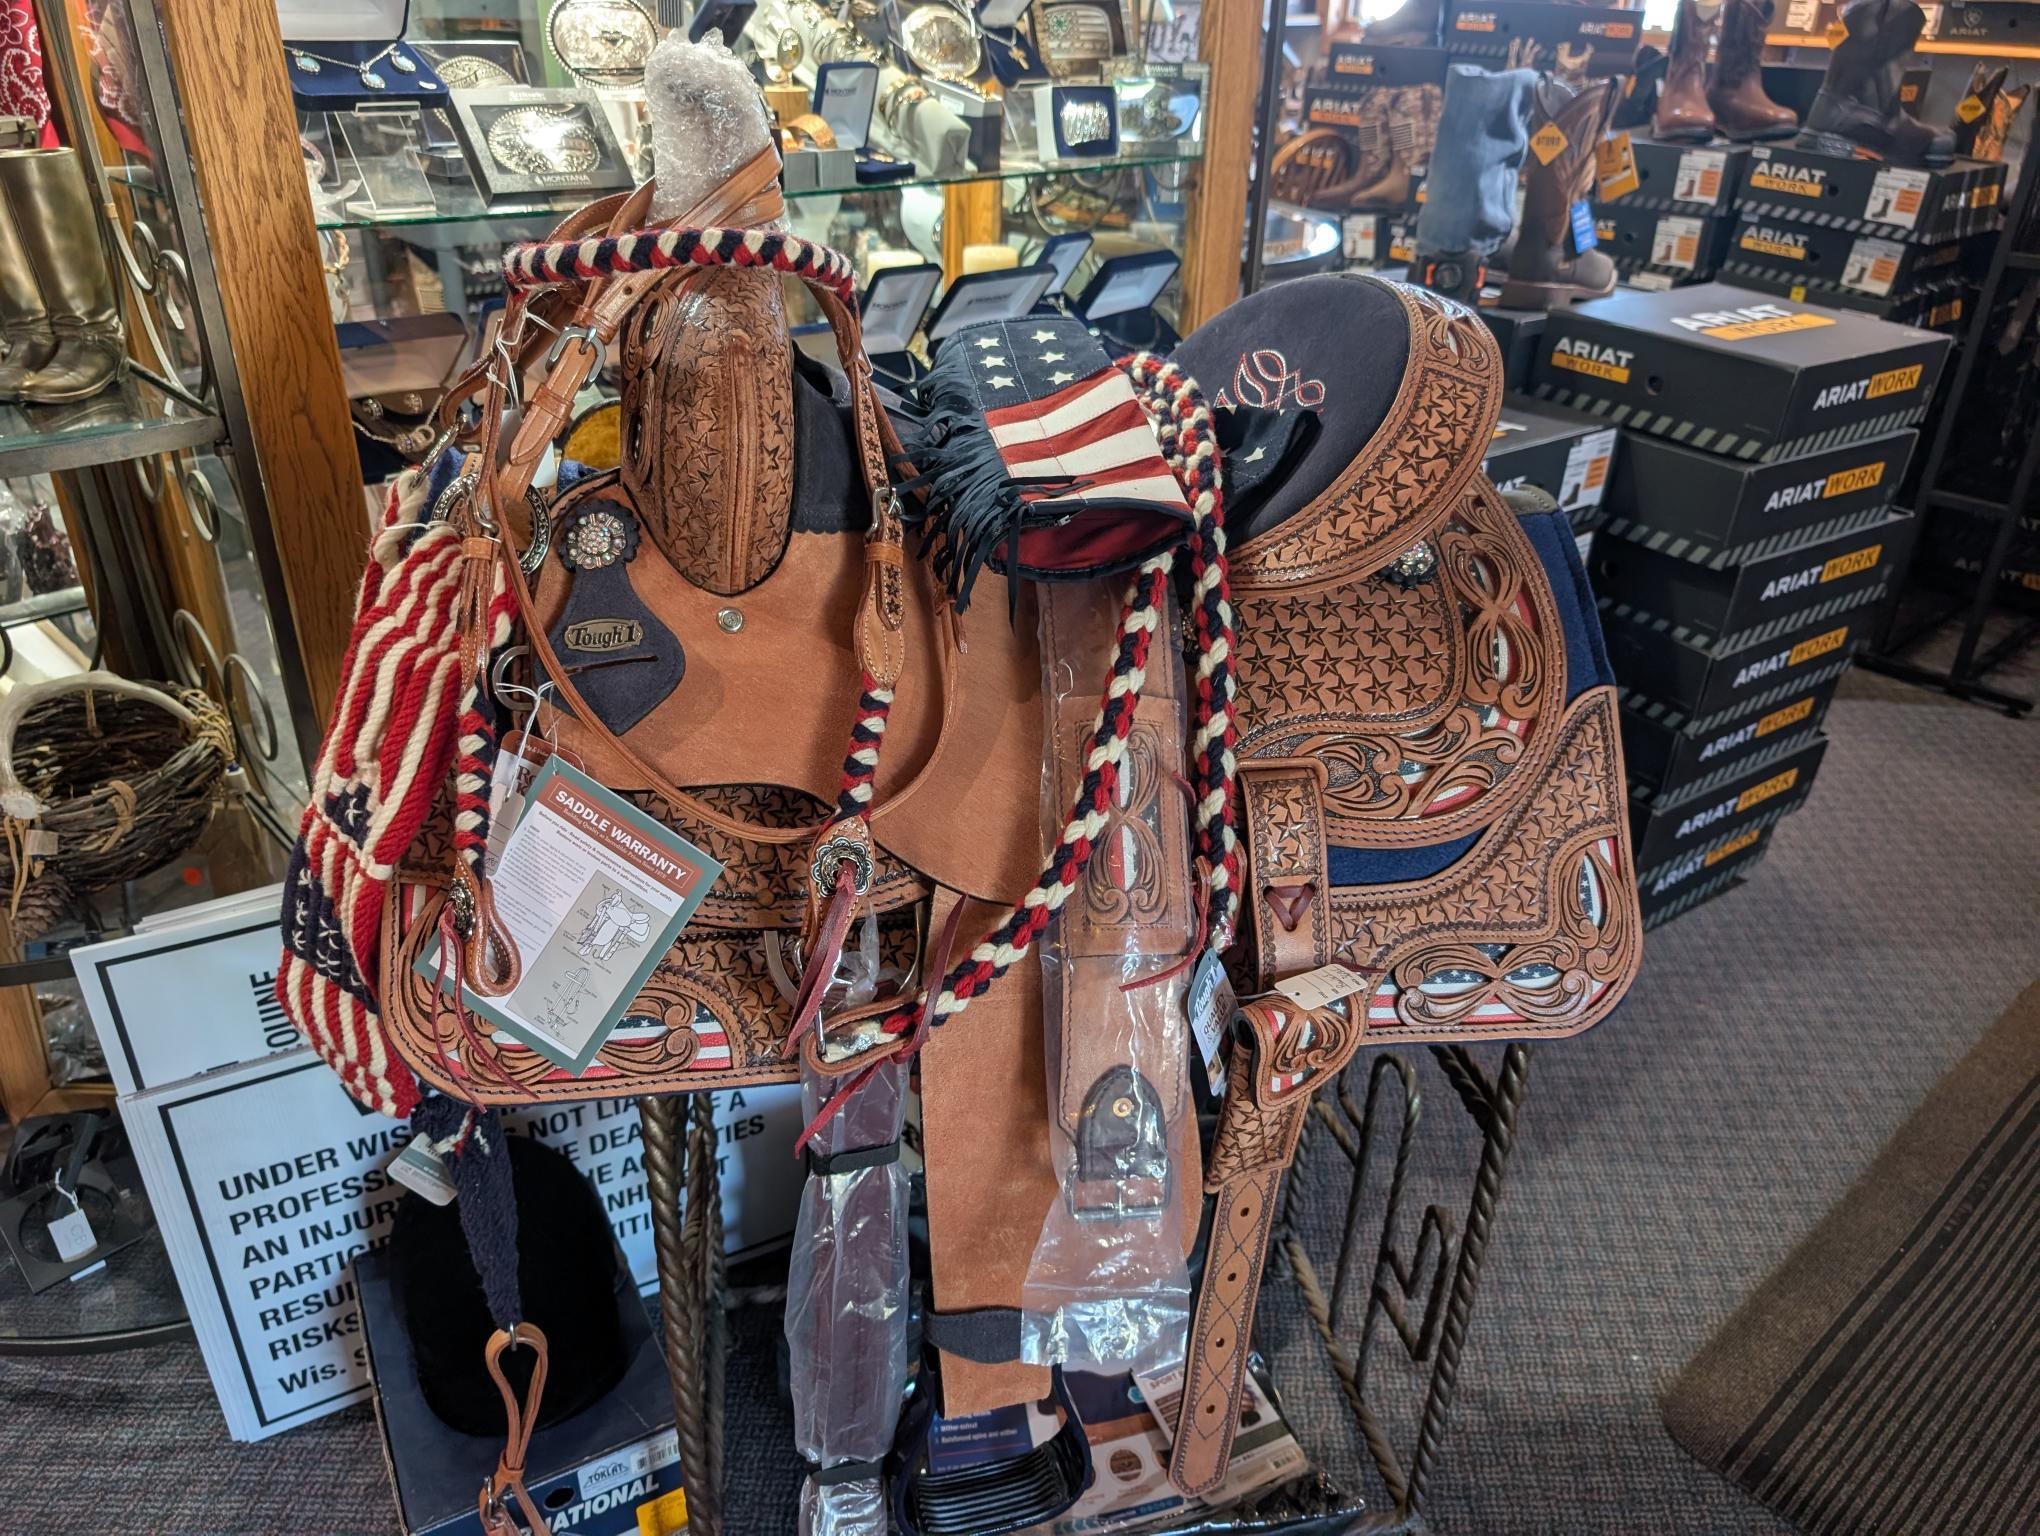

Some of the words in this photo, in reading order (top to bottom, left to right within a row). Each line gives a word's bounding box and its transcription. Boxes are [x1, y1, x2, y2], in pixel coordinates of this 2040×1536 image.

[1949, 27, 1988, 37] ARIAT
[1754, 161, 1827, 184] ARIAT
[1764, 178, 1807, 194] WORK
[1744, 225, 1809, 247] ARIAT
[1752, 242, 1792, 257] WORK
[1669, 303, 1792, 332] ARIAT
[1554, 336, 1634, 368] ARIAT
[1566, 357, 1613, 378] WORK
[1812, 379, 1870, 411] ARIAT
[1869, 367, 1918, 395] WORK
[1764, 479, 1826, 512] ARIAT
[1826, 465, 1881, 495] WORK
[1760, 565, 1822, 601] ARIAT
[1822, 547, 1877, 579] WORK
[1732, 650, 1791, 688] ARIAT
[1791, 631, 1843, 662] WORK
[1698, 722, 1758, 762] ARIAT
[555, 790, 611, 832] SADDLE
[611, 825, 687, 881] WARRANTY
[1675, 797, 1738, 839] ARIAT
[1652, 853, 1706, 896] ARIAT
[528, 1104, 586, 1141] NOT
[218, 1147, 340, 1201] UNDER
[242, 1235, 289, 1269] AN
[299, 1198, 401, 1249] INJUR
[729, 1090, 747, 1112] A
[278, 1364, 346, 1395] Wis.
[588, 1464, 623, 1484] TOKLAT
